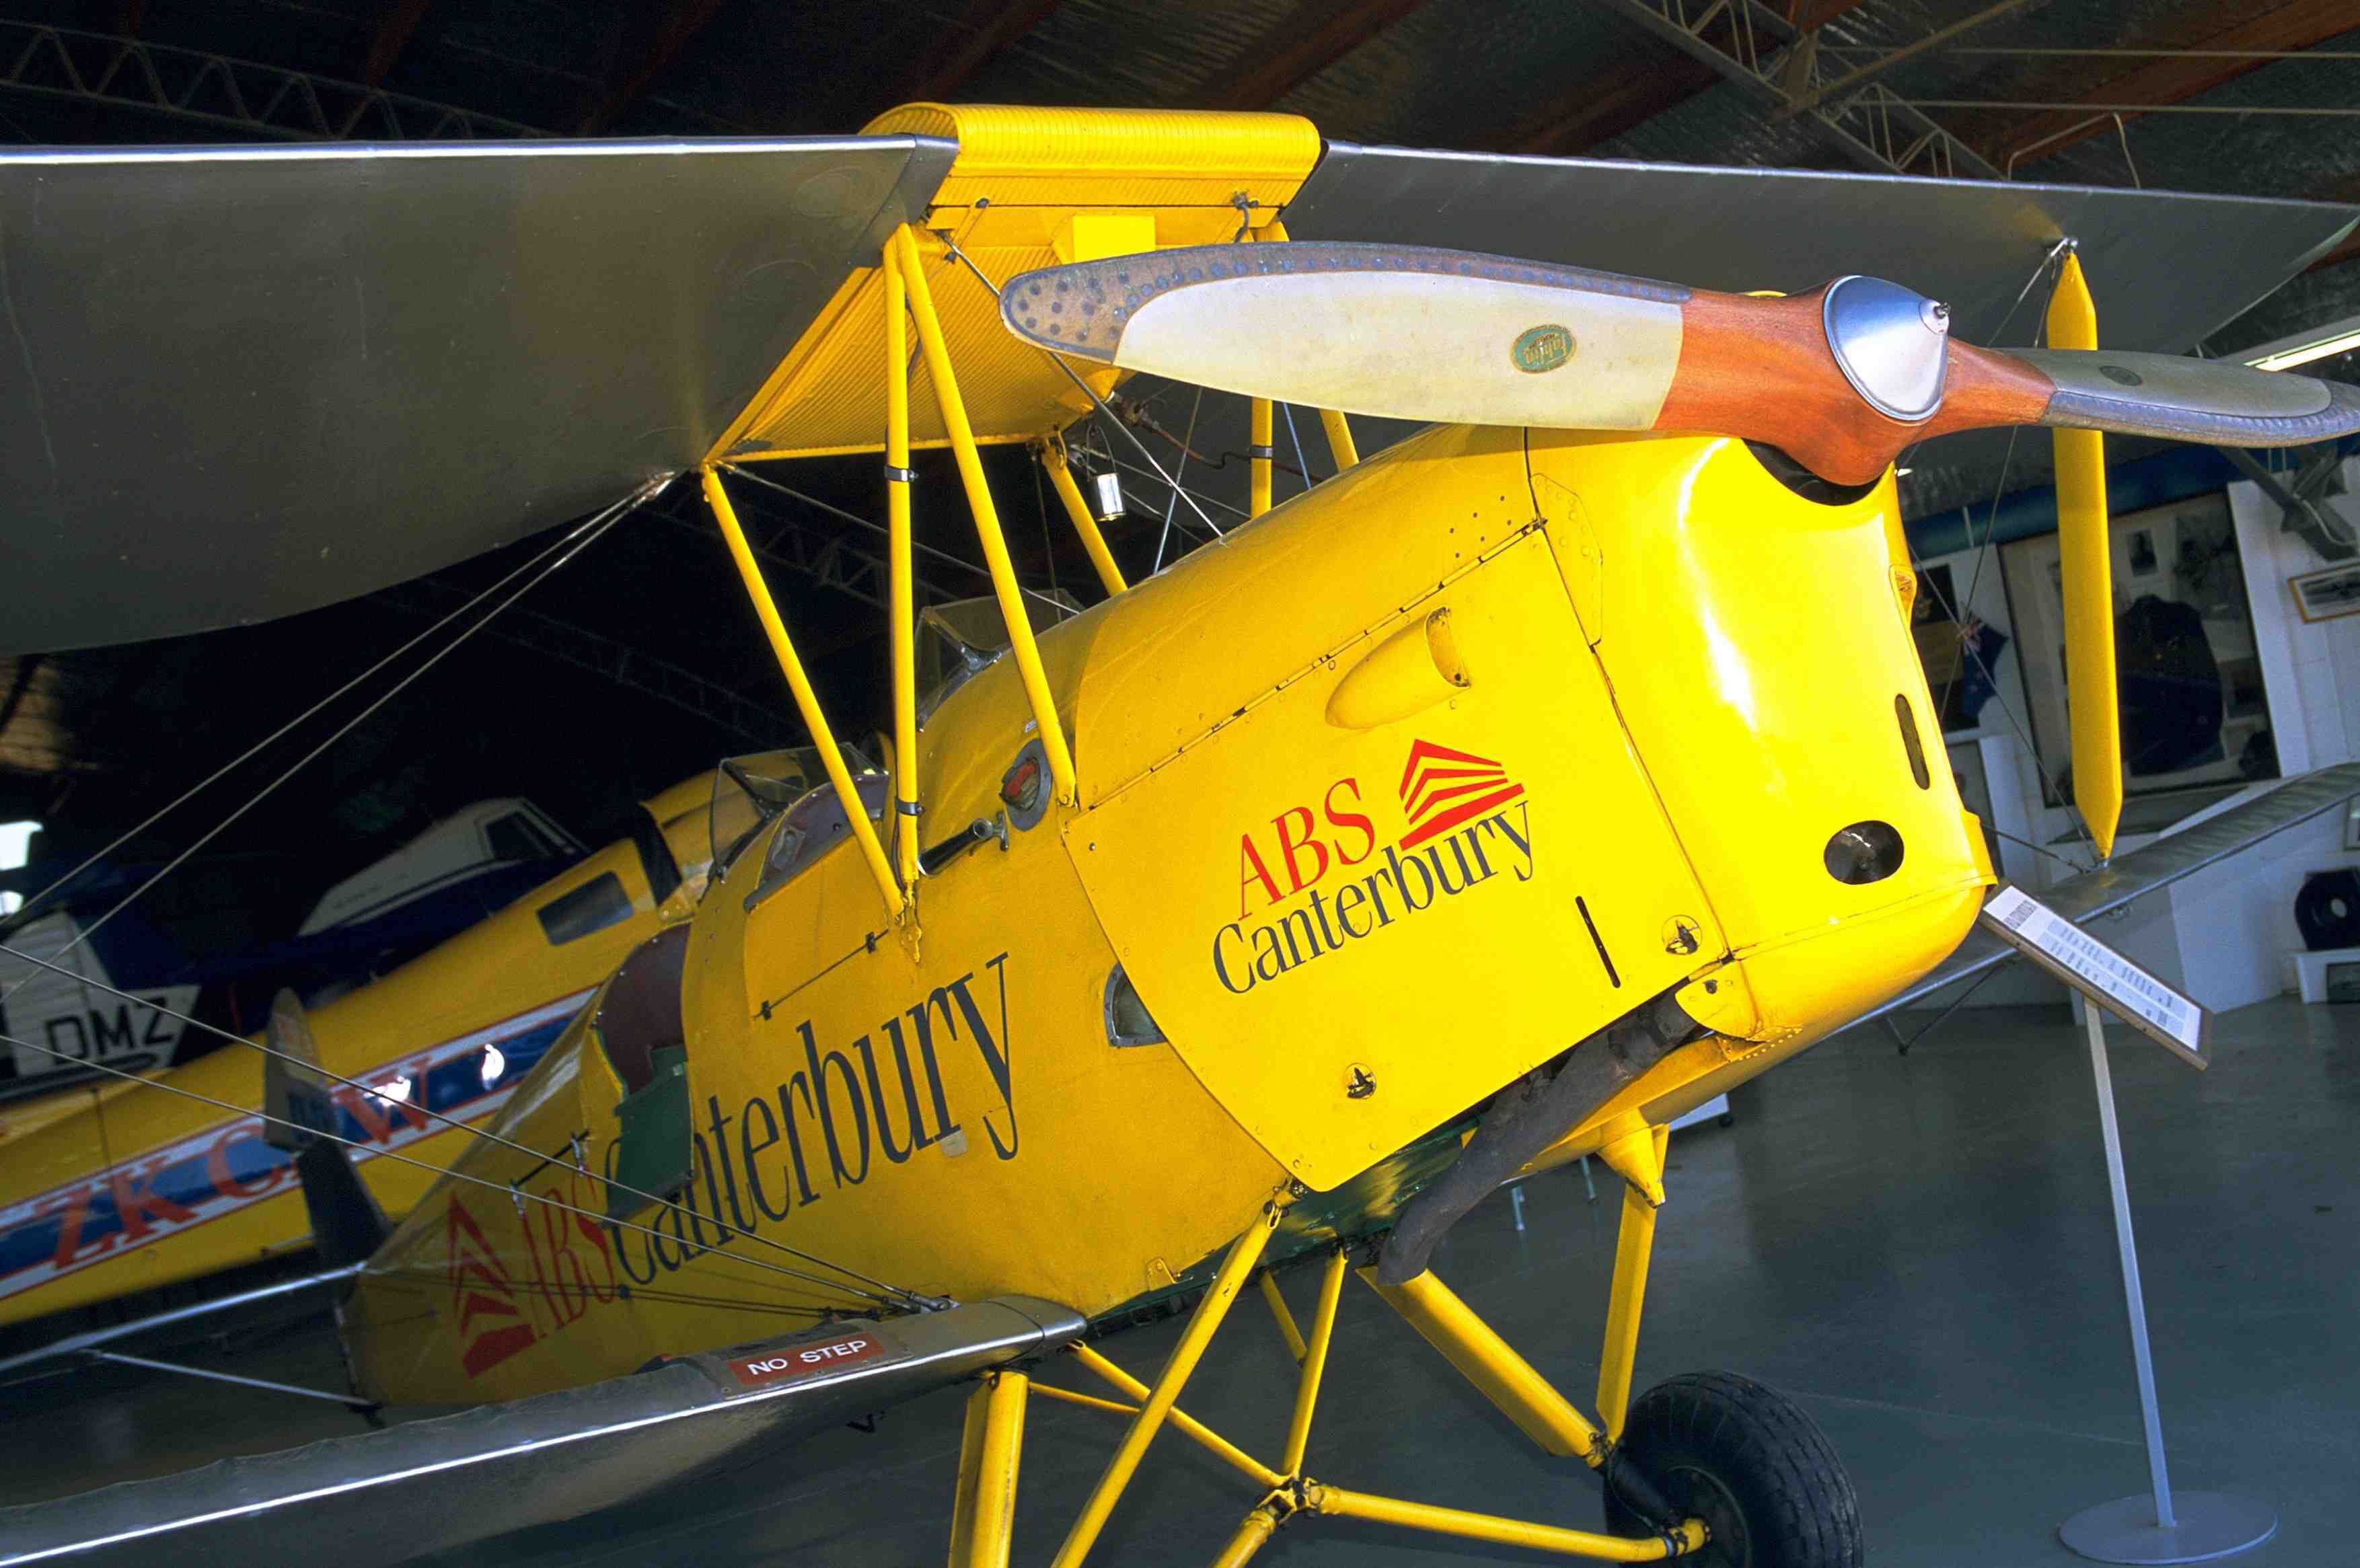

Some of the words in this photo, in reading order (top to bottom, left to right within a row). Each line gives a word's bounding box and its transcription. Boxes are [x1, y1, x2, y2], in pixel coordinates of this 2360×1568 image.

[1213, 800, 1533, 994] Canterbury
[1238, 778, 1375, 921] ABS
[747, 1358, 788, 1375] NO
[800, 1340, 867, 1363] STEP
